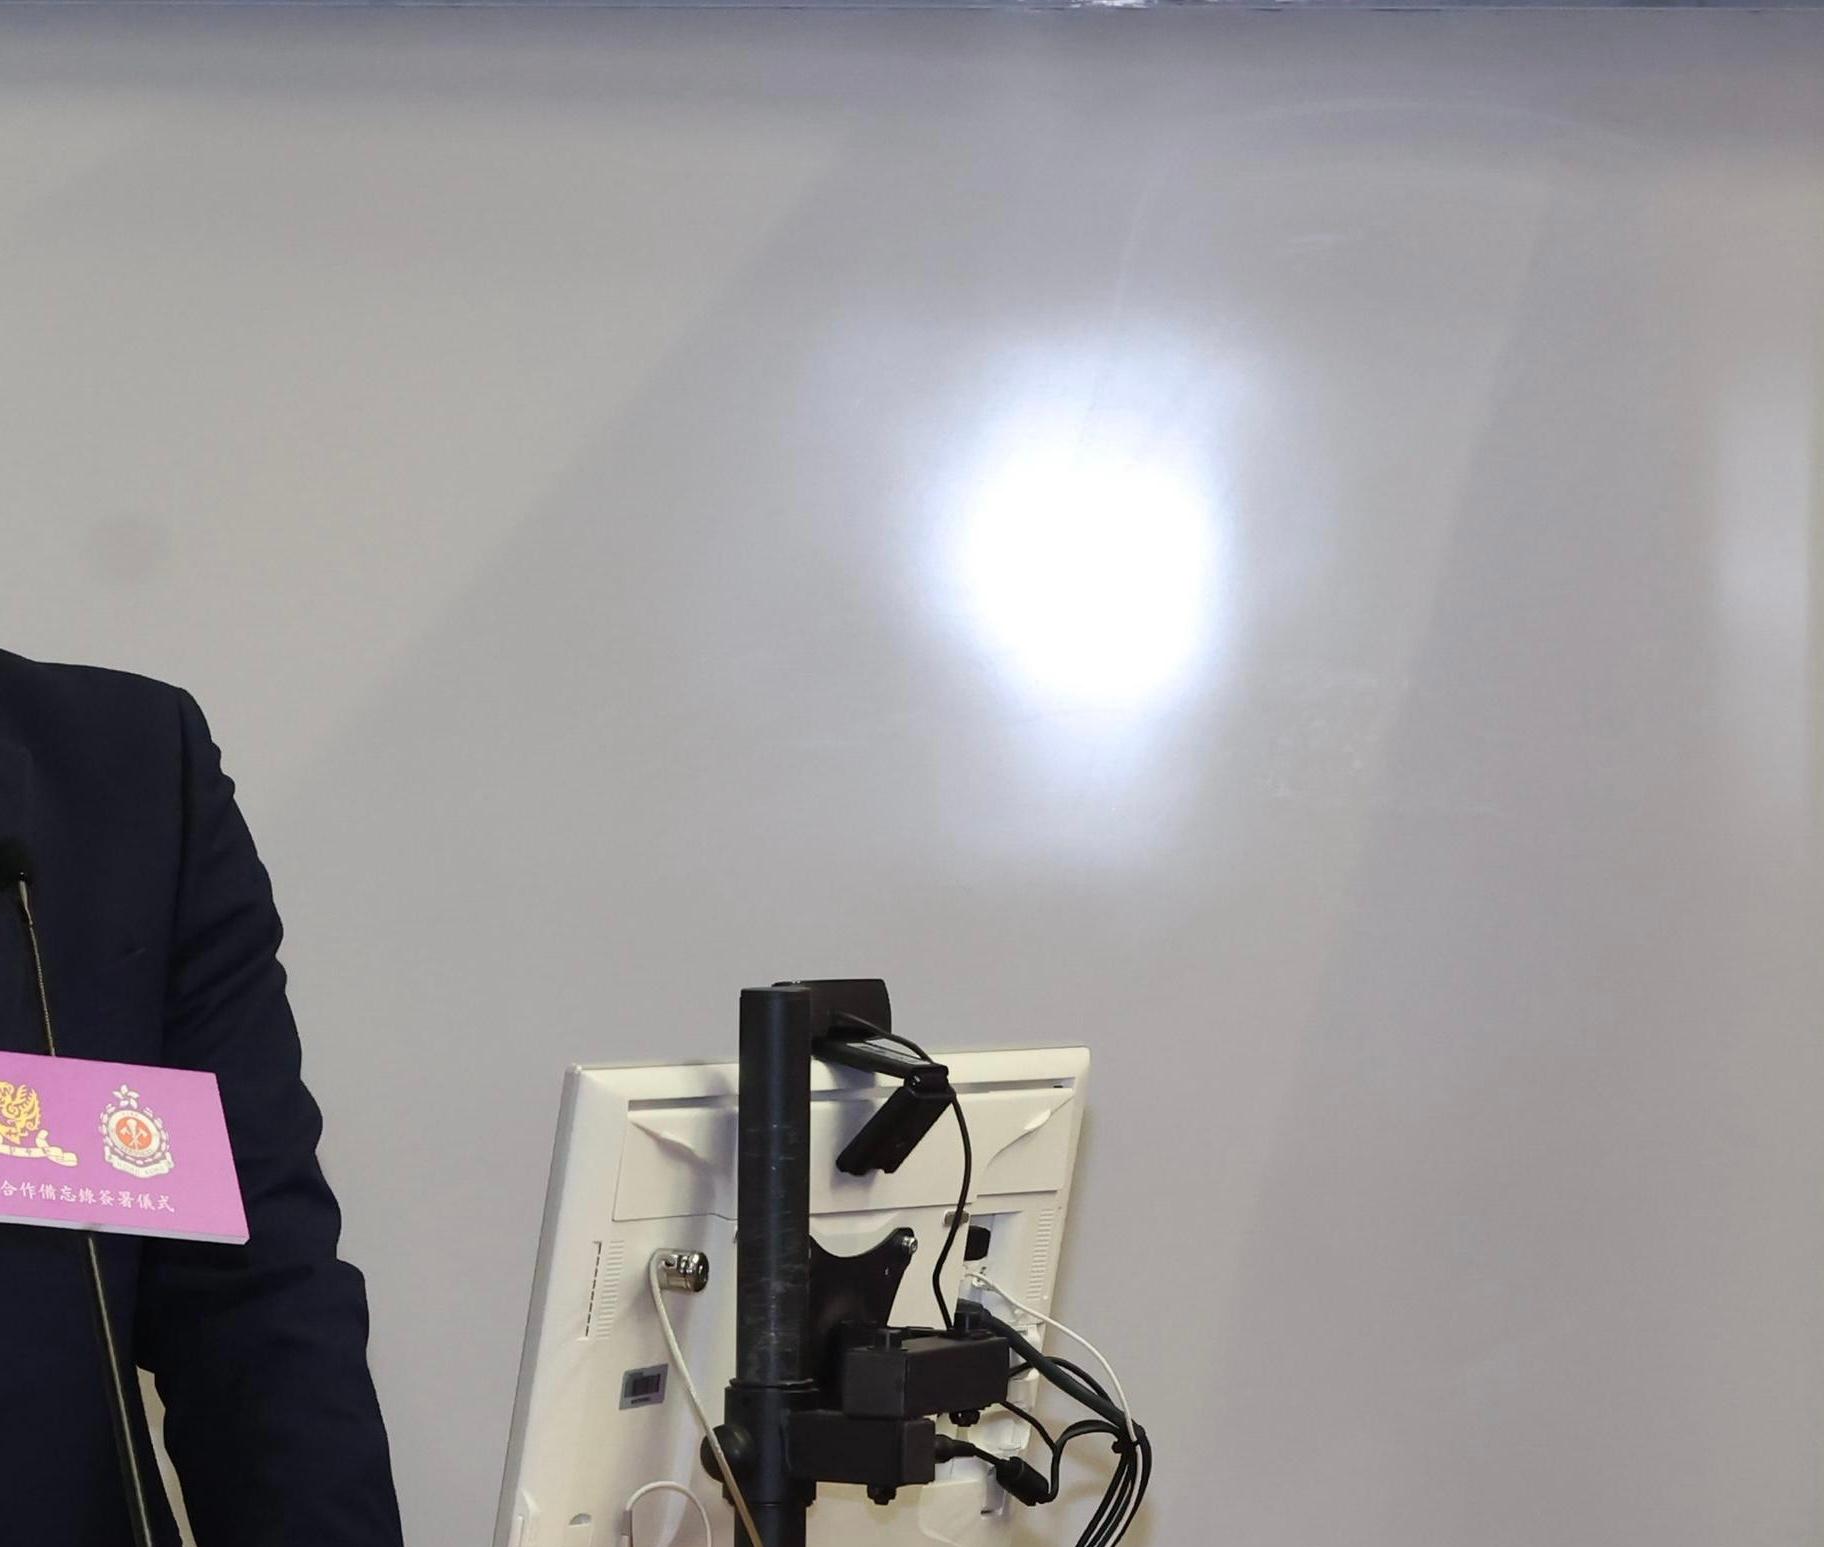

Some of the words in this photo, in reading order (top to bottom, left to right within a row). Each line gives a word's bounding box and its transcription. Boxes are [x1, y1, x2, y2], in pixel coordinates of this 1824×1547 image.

[0, 1179, 176, 1213] 合作備忘錄簽署儀式
